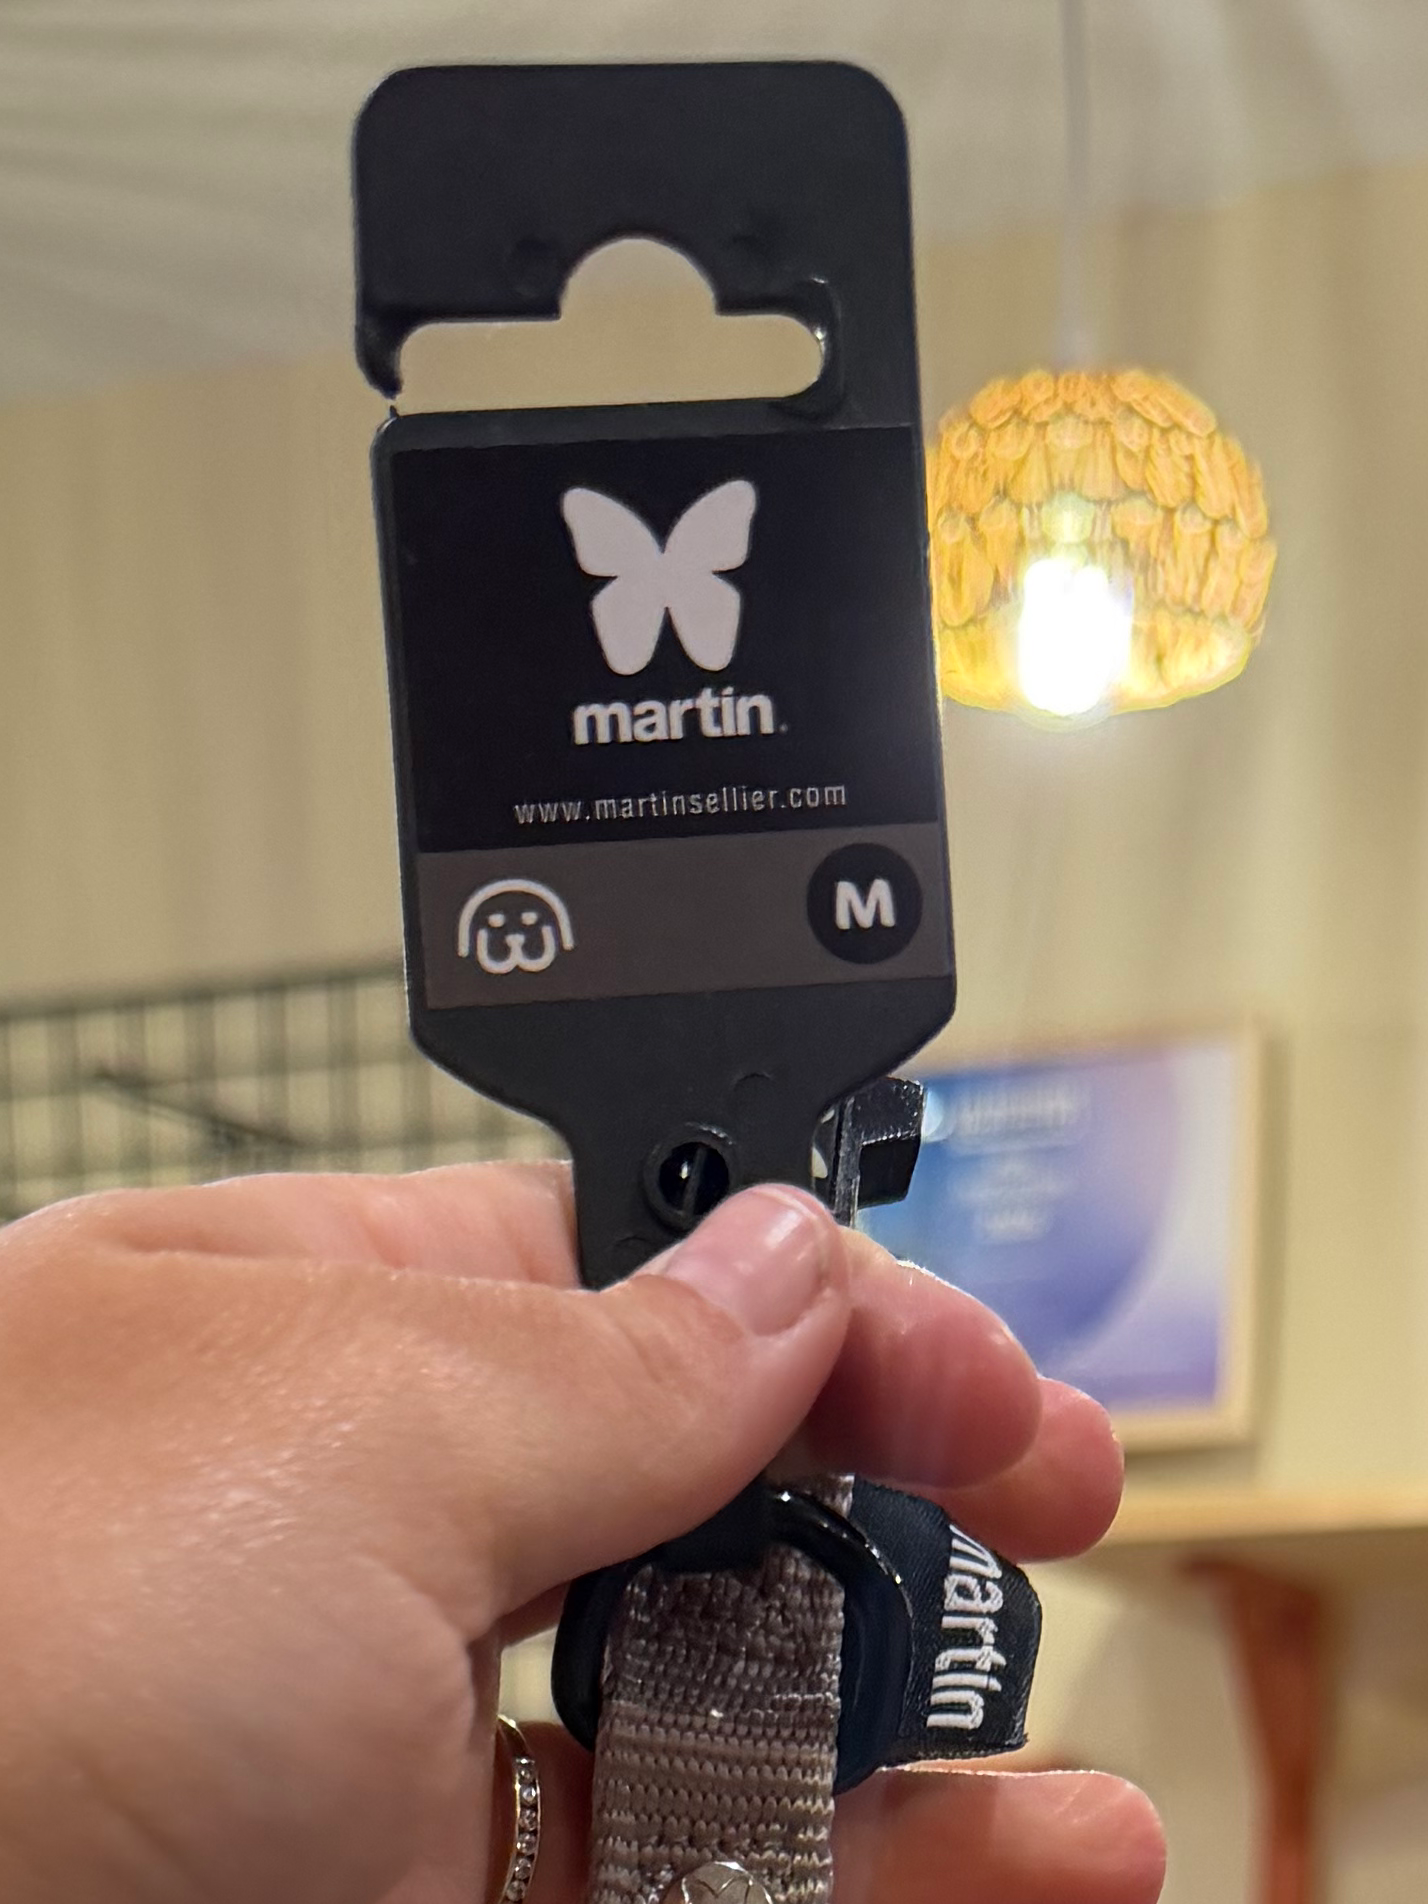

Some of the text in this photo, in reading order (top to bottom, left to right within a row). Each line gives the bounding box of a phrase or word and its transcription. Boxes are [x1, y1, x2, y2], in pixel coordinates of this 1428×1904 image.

[572, 685, 775, 746] martin
[514, 784, 848, 826] www.martinsellier.com
[835, 880, 896, 931] M
[926, 1524, 1007, 1730] martin
